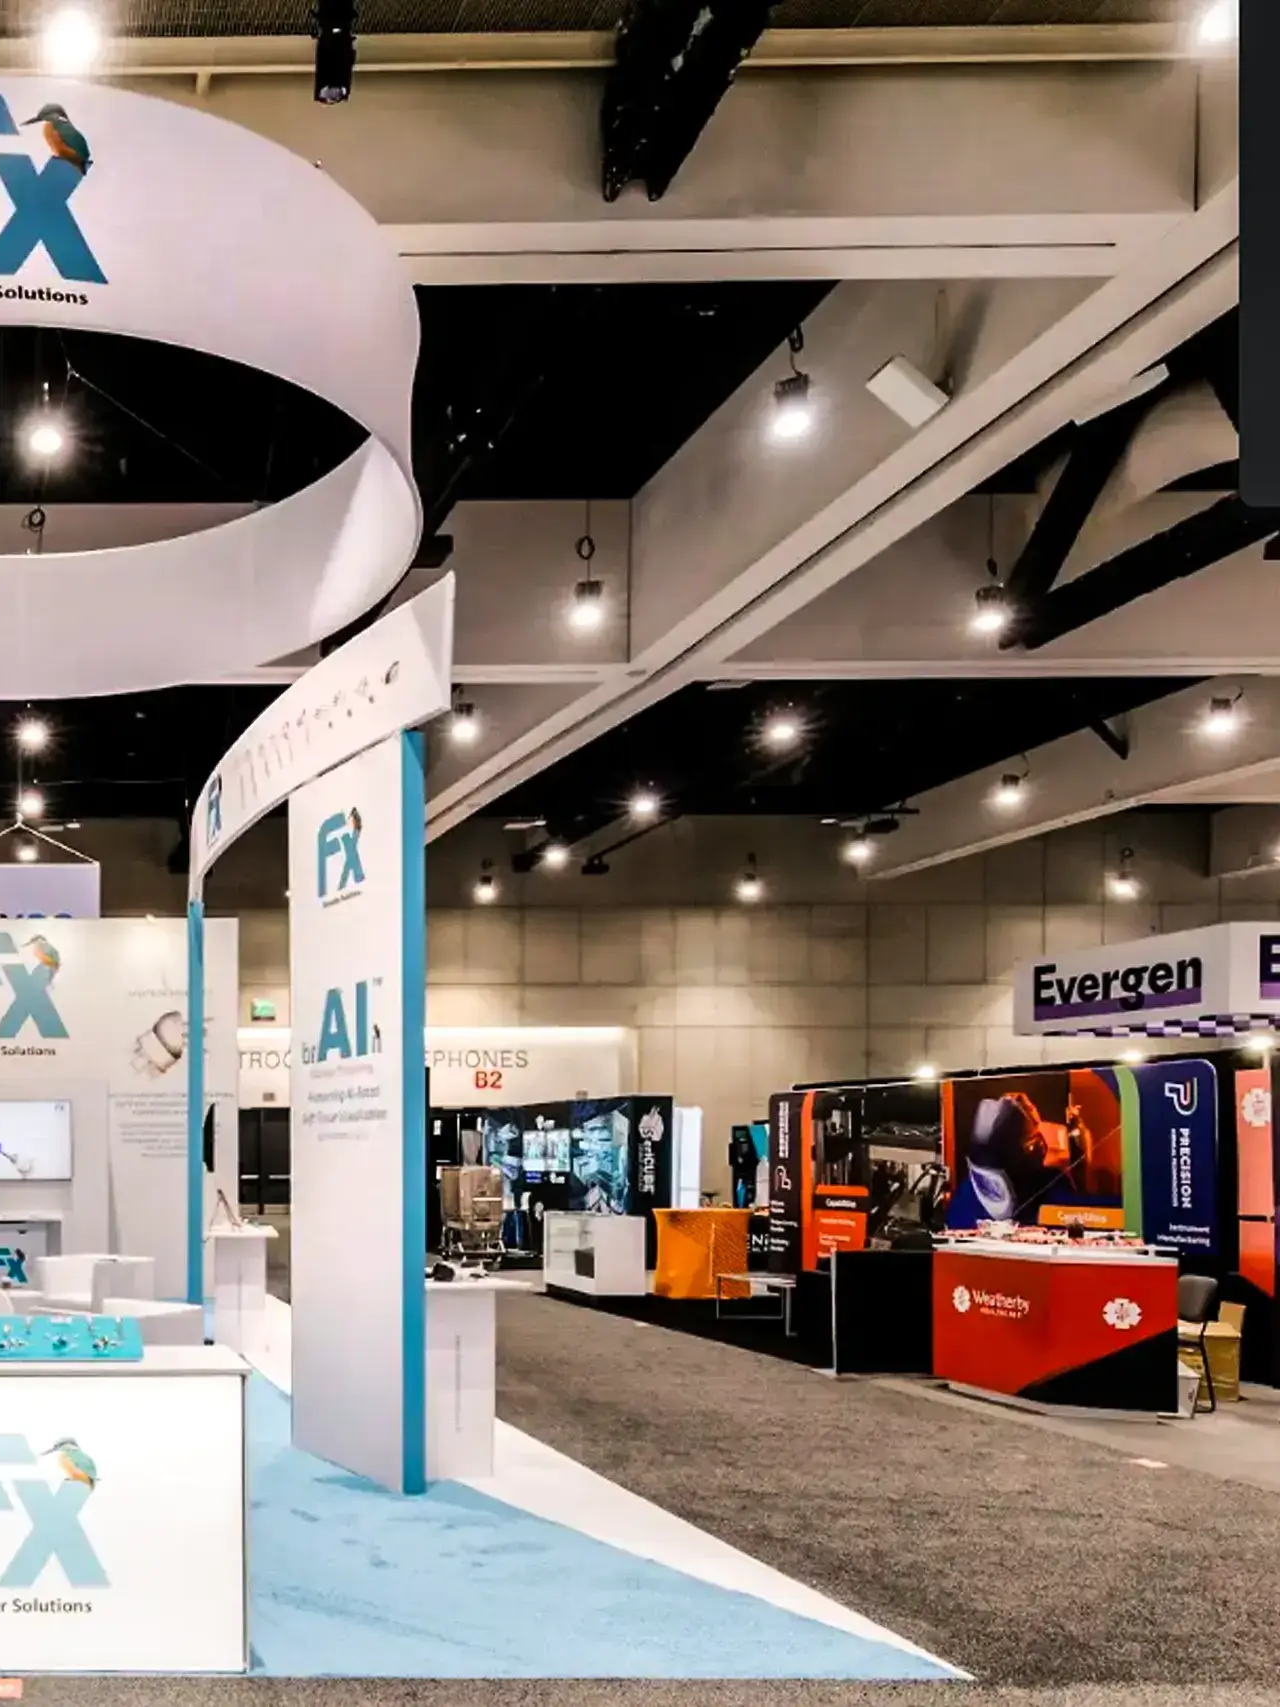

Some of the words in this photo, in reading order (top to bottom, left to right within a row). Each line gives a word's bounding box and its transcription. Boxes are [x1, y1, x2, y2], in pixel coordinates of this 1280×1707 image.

[1034, 956, 1203, 1012] Evergen
[0, 1045, 57, 1056] Solutions
[425, 1049, 529, 1069] PHONES
[475, 1070, 503, 1090] B2
[1179, 1127, 1193, 1209] PRECISION
[972, 1288, 1031, 1314] Weatherby
[12, 1598, 93, 1613] Solutions
